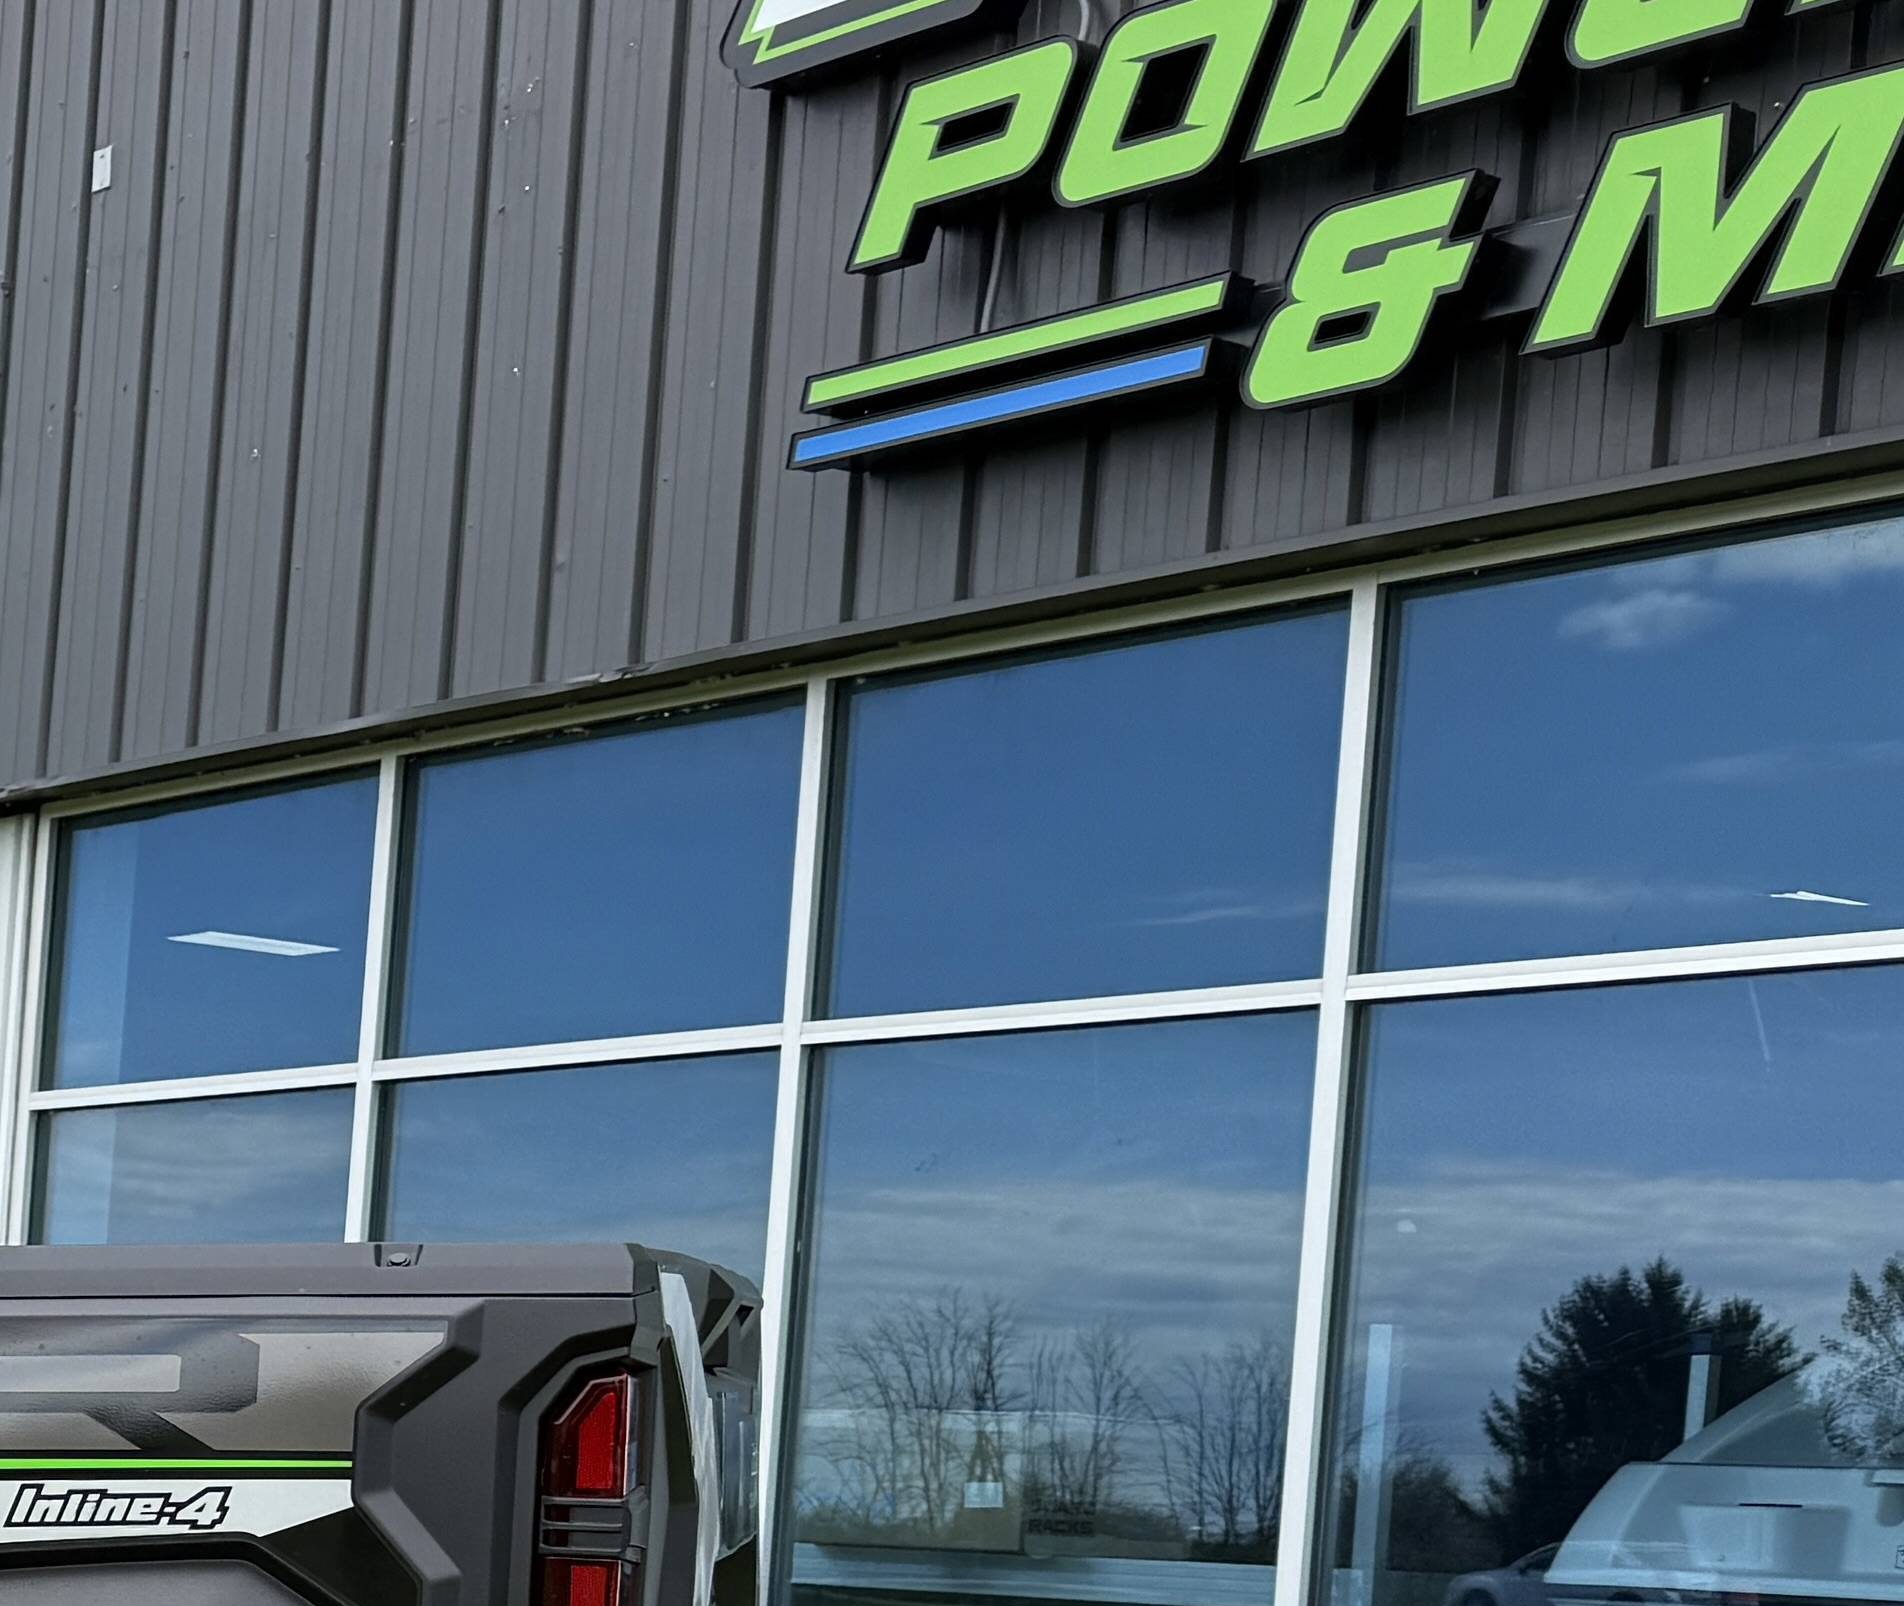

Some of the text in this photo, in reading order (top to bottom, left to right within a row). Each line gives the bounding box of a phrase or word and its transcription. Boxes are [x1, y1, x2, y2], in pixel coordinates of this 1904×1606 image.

[1241, 58, 1904, 410] & M
[3, 1483, 233, 1531] Inline-4
